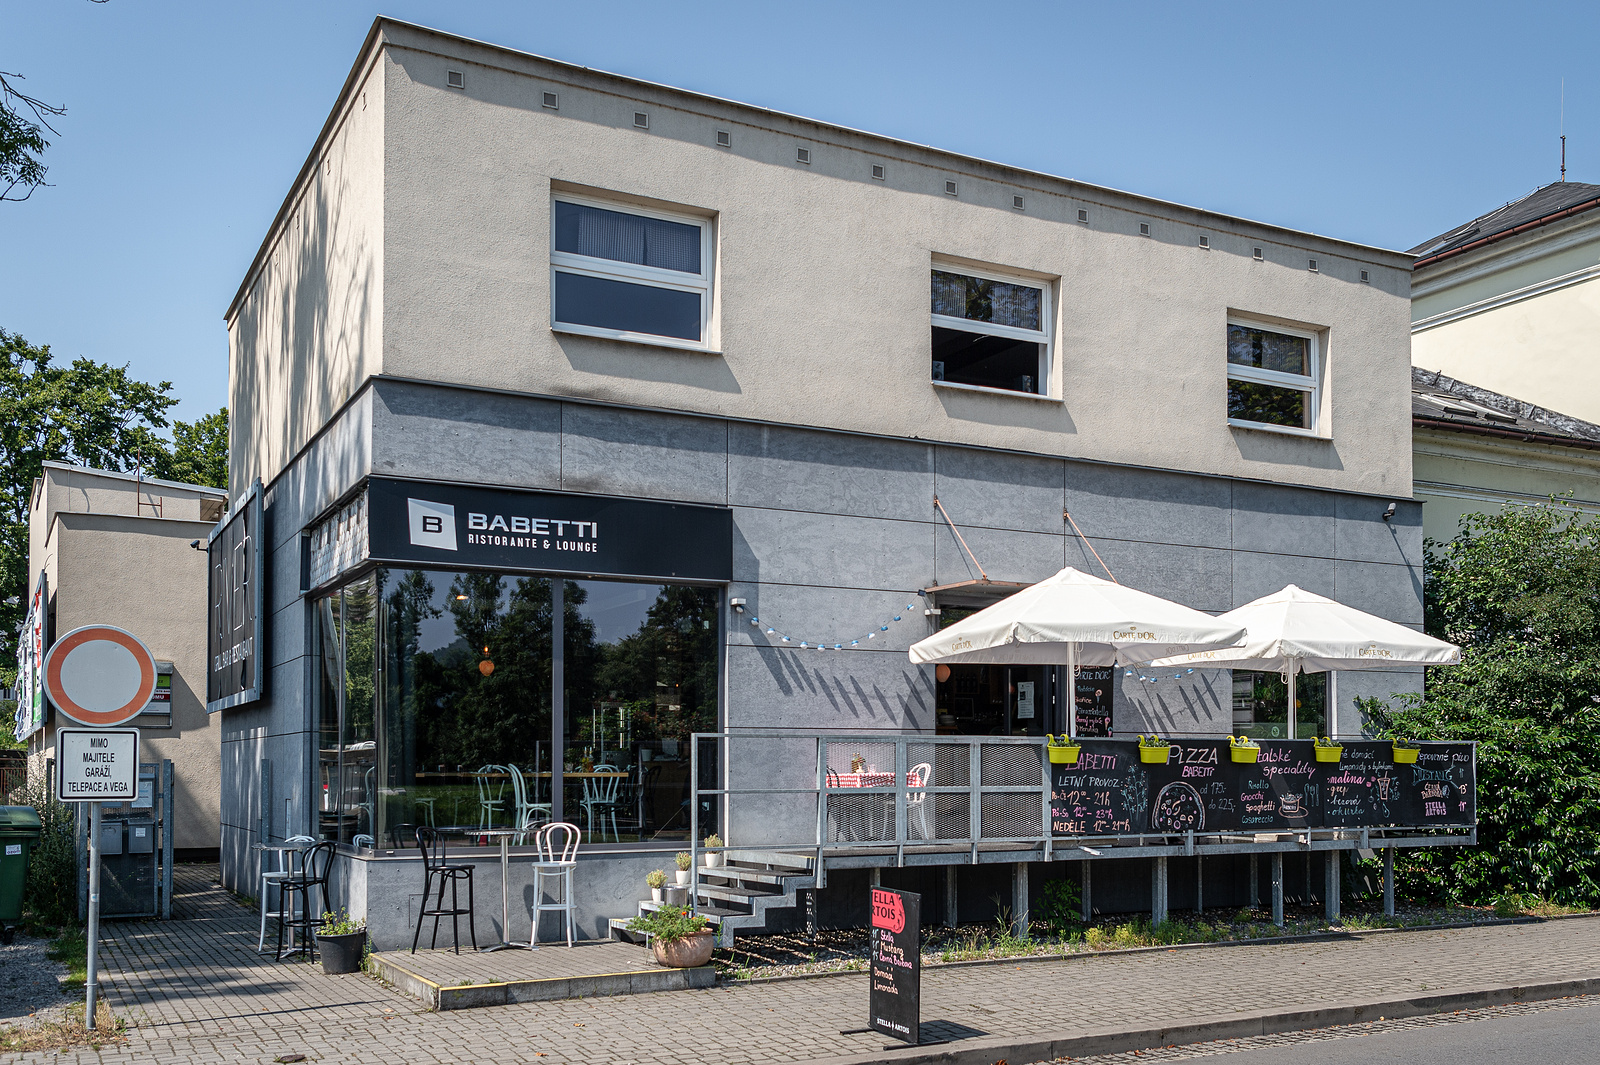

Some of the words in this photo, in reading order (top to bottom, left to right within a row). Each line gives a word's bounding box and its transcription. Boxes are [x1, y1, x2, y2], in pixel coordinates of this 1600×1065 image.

[422, 515, 443, 533] B
[468, 512, 598, 539] BABETTI
[468, 533, 537, 549] RISTORANTE
[543, 539, 551, 550] &
[556, 540, 598, 553] LOUNGE
[1113, 630, 1136, 640] CARTE
[1359, 648, 1376, 657] CARTE
[90, 738, 108, 748] MIMO
[83, 752, 115, 763] MAJITELE
[1416, 749, 1449, 766] epované
[1452, 751, 1470, 767] pivo
[85, 765, 112, 779] GARÁŽÍ,
[1331, 770, 1366, 785] malina
[68, 782, 102, 792] TELEPACE
[103, 782, 108, 792] A
[110, 782, 128, 792] VEGA
[1058, 775, 1087, 787] LETNÍ
[1089, 776, 1124, 787] PROVOZ:
[1245, 801, 1276, 815] Spaghetti
[1425, 801, 1446, 809] STELLA
[1425, 809, 1447, 817] ARTOIS
[1052, 819, 1086, 833] NEDĚLE
[880, 929, 894, 944] Stella
[880, 941, 905, 961] Mustang
[876, 1018, 891, 1028] STELLA
[894, 1023, 910, 1034] ARTOIS
